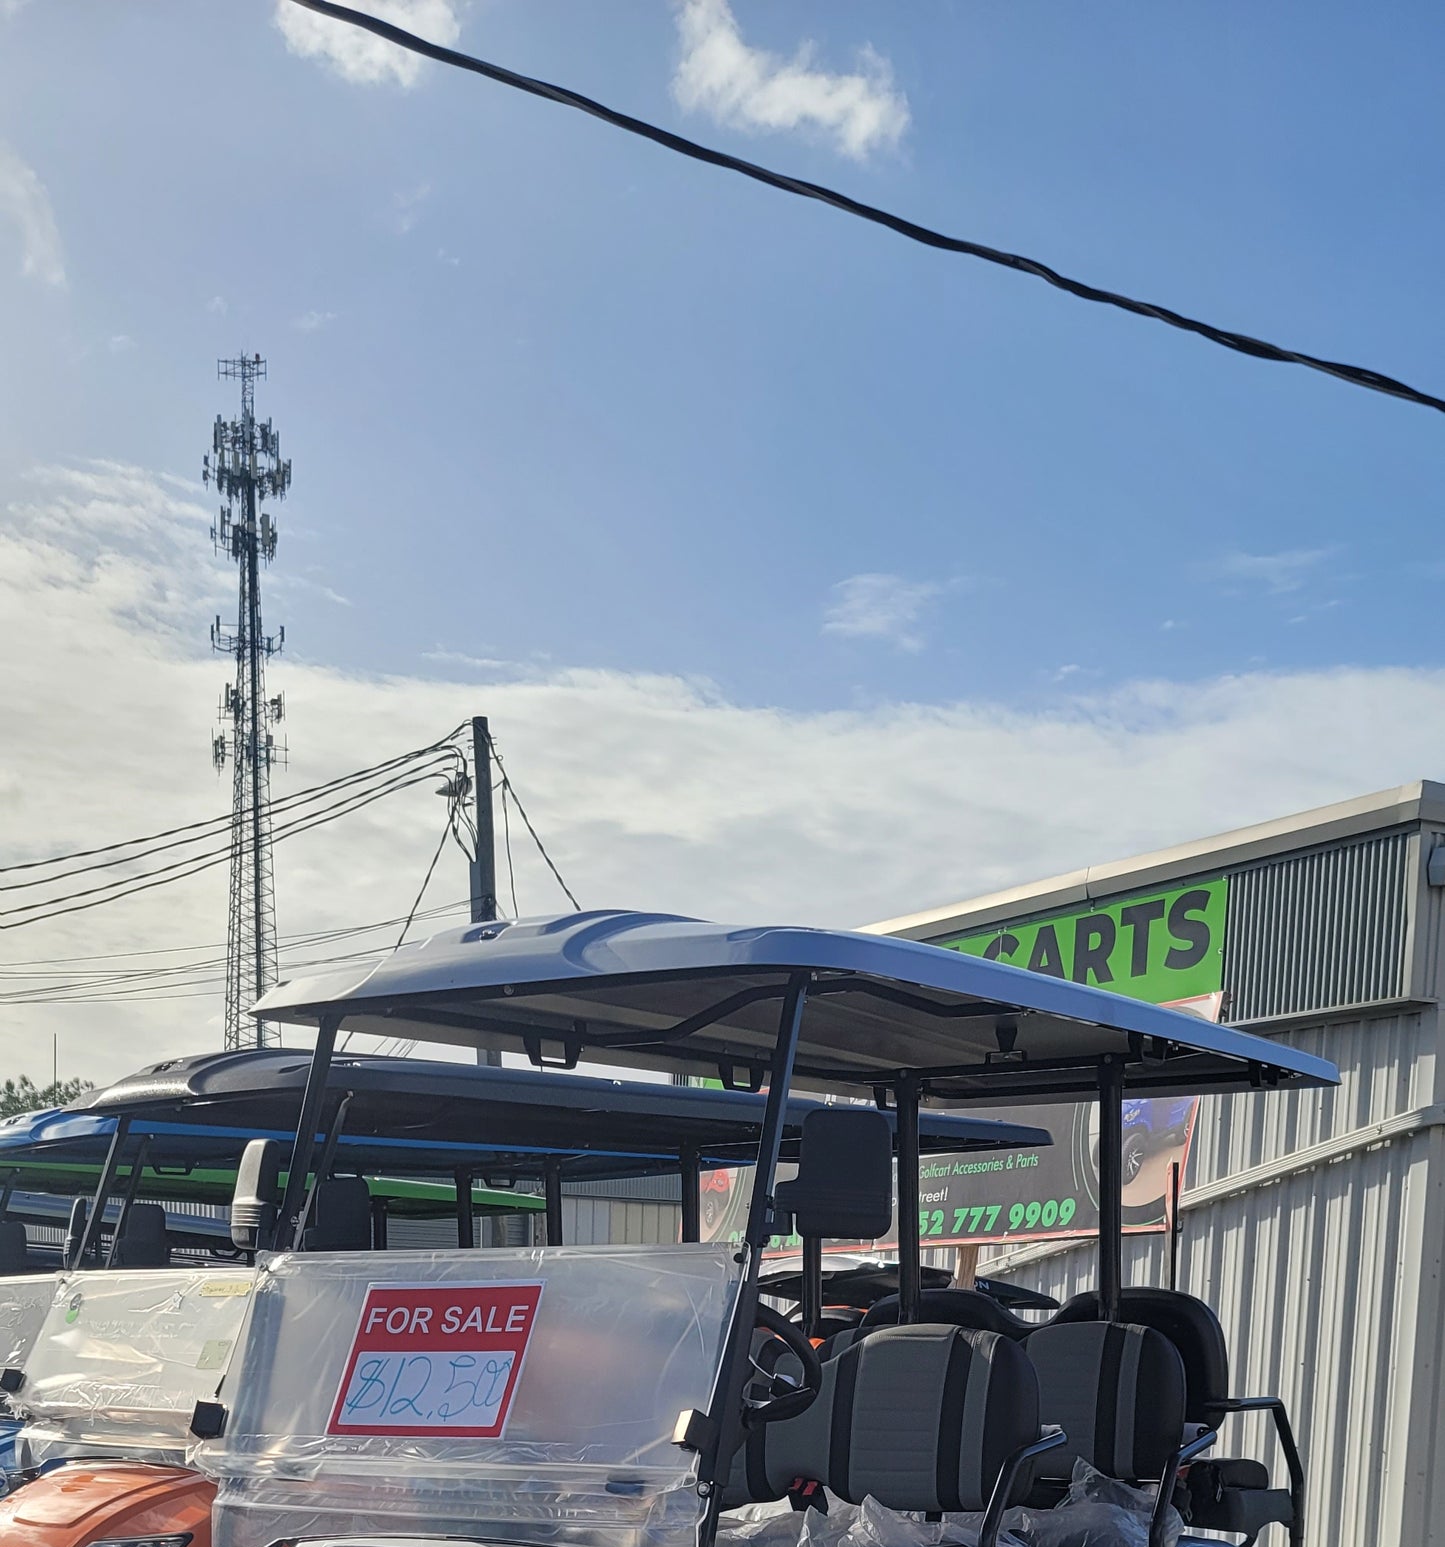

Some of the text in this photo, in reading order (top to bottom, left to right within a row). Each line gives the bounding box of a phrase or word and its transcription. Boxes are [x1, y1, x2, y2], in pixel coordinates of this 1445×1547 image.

[952, 1156, 1004, 1176] Accessories
[1006, 1154, 1013, 1170] &
[1015, 1153, 1039, 1168] Parts
[919, 1186, 949, 1203] treet!
[919, 1197, 1076, 1236] 52 777 9909
[365, 1305, 529, 1334] FOR SALE
